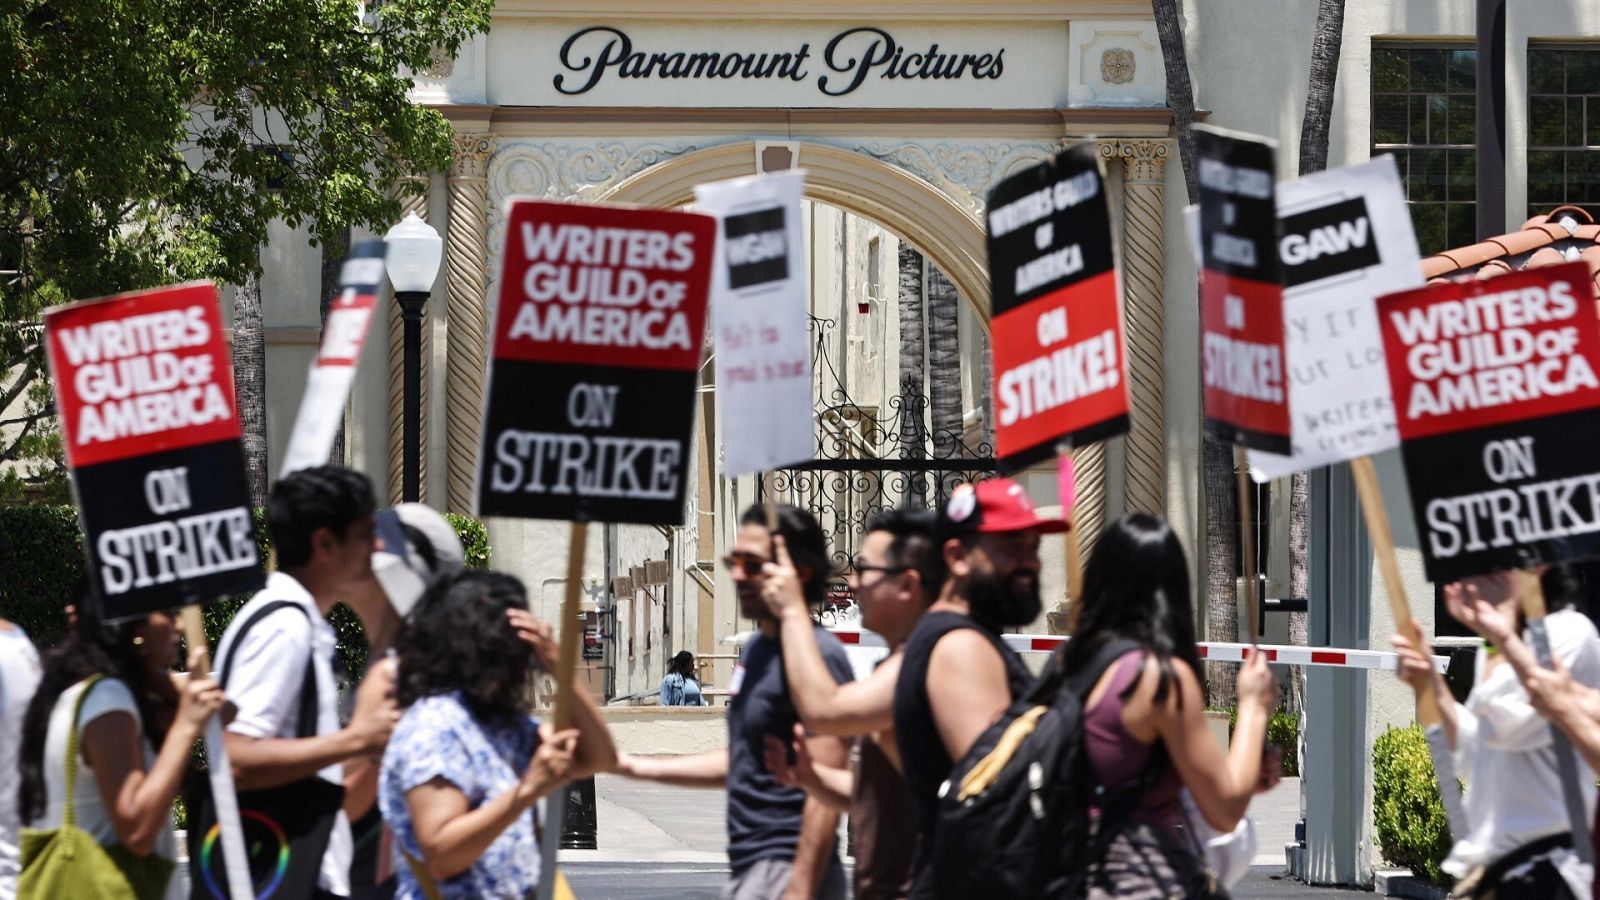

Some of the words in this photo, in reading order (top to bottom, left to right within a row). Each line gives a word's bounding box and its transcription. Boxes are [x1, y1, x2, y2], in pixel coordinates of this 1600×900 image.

[552, 26, 811, 95] Paramount
[817, 26, 1005, 96] Pictures
[520, 221, 695, 271] WRITERS
[1280, 216, 1368, 266] GAW
[523, 262, 648, 306] GUILD
[648, 279, 686, 310] OF
[58, 306, 211, 366] WRITERS
[508, 301, 692, 350] AMERICA
[1037, 305, 1069, 347] ON
[1389, 281, 1578, 346] WRITERS
[74, 351, 183, 405] GUILD
[183, 354, 214, 387] OF
[998, 329, 1120, 427] STRIKE!
[1406, 328, 1535, 381] GUILD
[1535, 326, 1579, 358] OF
[567, 382, 621, 427] ON
[1406, 354, 1599, 420] AMERICA
[76, 383, 231, 446] AMERICA
[490, 429, 682, 500] STRIKE
[1483, 435, 1536, 483] ON
[144, 466, 192, 516] ON
[97, 506, 259, 595] STRIKE
